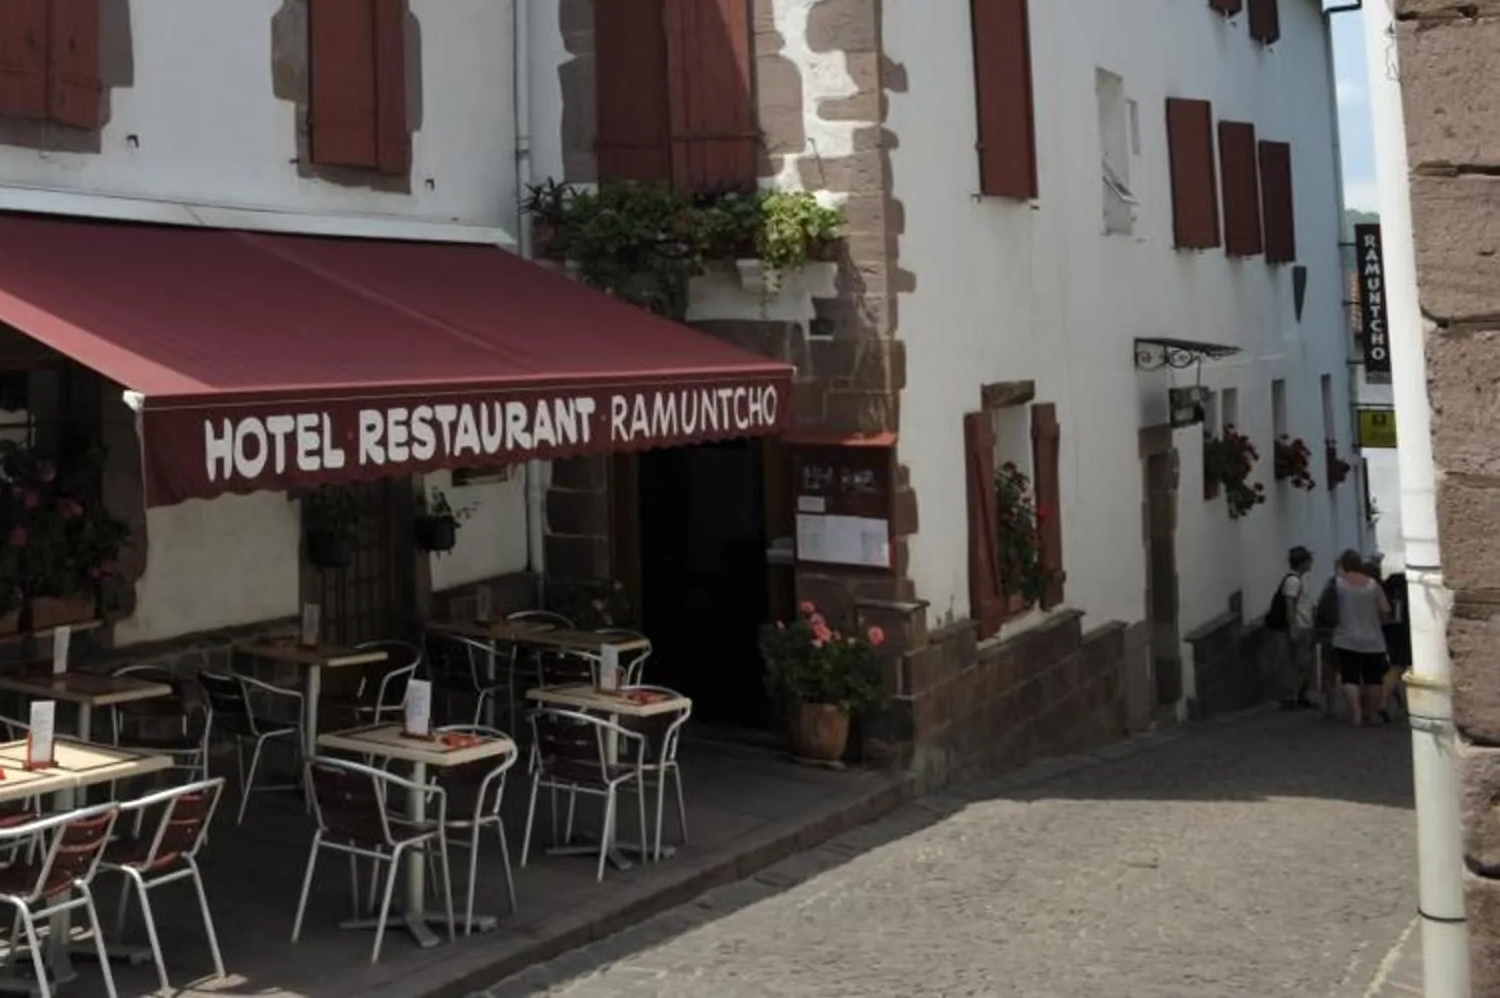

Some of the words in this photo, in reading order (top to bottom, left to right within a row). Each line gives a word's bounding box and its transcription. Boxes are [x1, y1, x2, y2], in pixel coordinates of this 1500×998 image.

[1364, 234, 1385, 360] RAMUNTCHO
[205, 412, 345, 482] HOTEL
[359, 397, 596, 465] RESTAURANT
[611, 385, 778, 442] RAMUNTCHO
